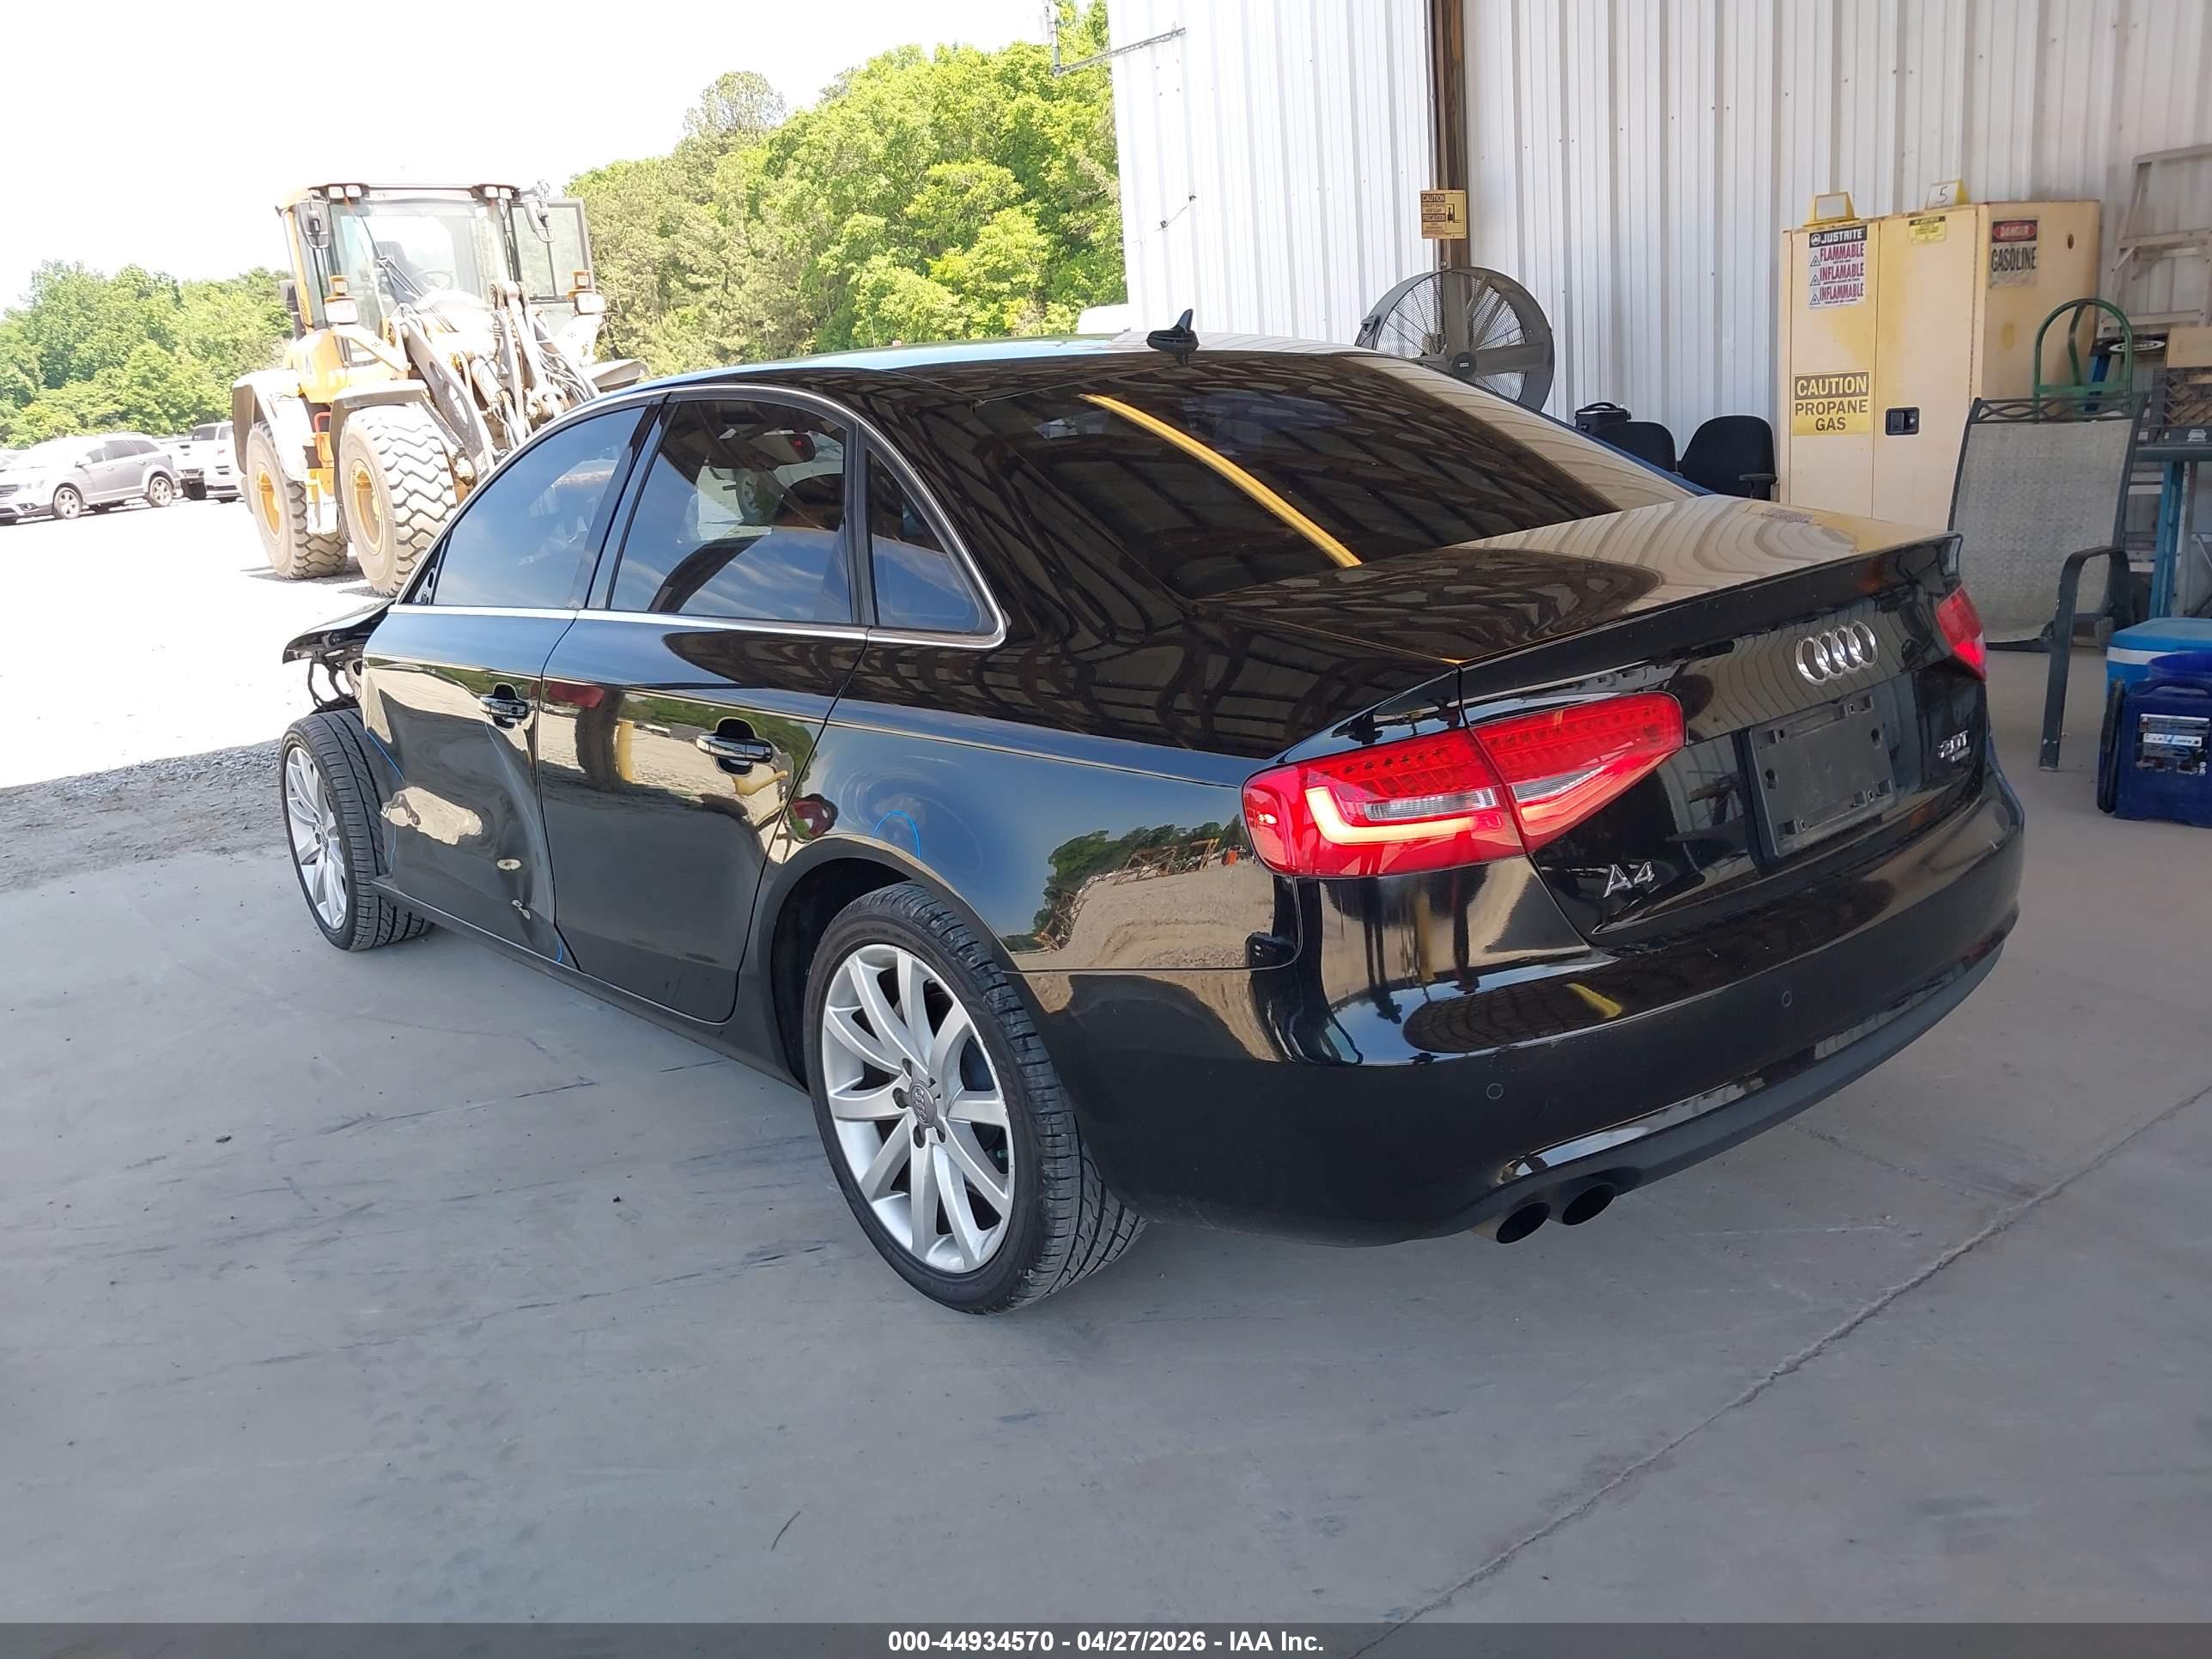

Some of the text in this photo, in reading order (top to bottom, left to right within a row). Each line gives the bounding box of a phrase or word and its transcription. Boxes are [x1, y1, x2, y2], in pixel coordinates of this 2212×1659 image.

[1938, 185, 1948, 204] 5
[1821, 228, 1863, 244] JUSTRITE
[1820, 242, 1865, 263] FLAMMABLE
[1990, 246, 2037, 272] GASOLINE
[1820, 262, 1865, 282] INFLAMABLE
[1820, 283, 1864, 301] INFLAMMABLE
[1796, 375, 1868, 397] CAUTION
[1795, 398, 1869, 416] PROPANE
[1815, 416, 1847, 431] GAS
[1603, 861, 1656, 898] A4
